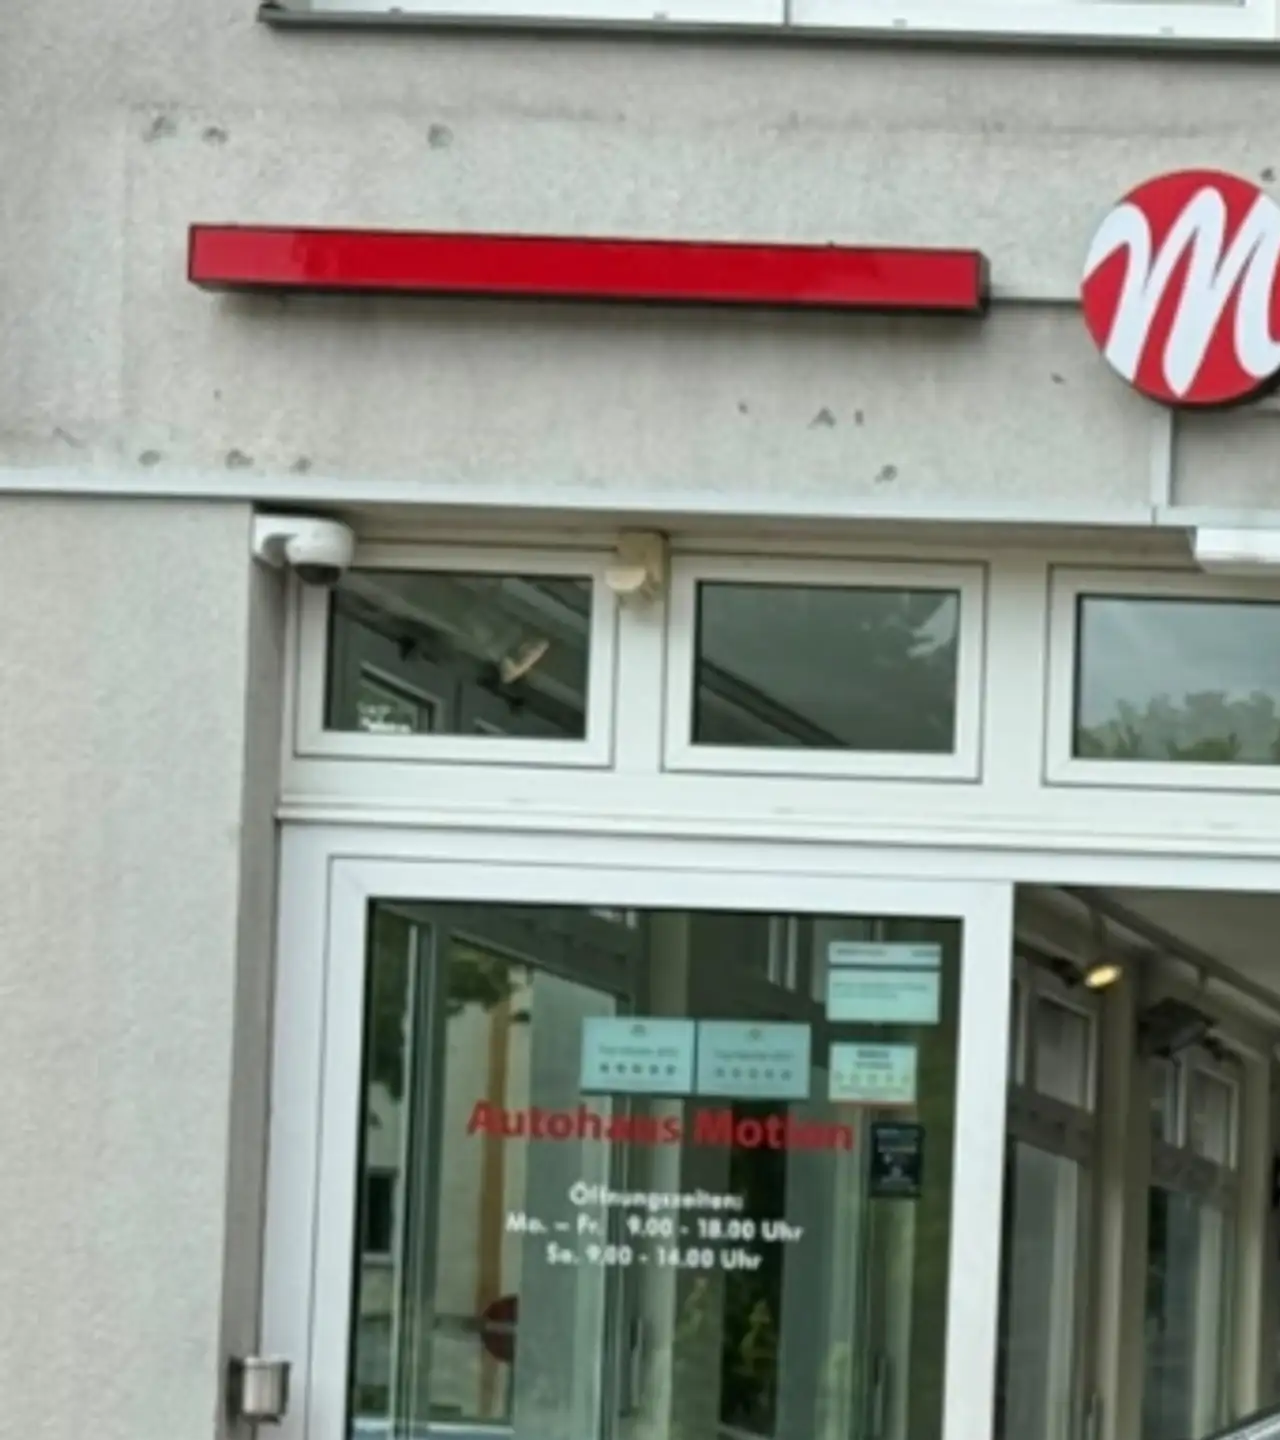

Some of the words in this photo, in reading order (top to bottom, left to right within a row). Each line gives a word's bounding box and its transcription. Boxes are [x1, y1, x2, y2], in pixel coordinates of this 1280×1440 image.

[467, 1102, 681, 1145] Autohaus
[693, 1108, 854, 1151] Motion
[626, 1216, 673, 1237] 9.00
[698, 1217, 756, 1240] 18.00
[761, 1219, 804, 1242] Uhr
[721, 1247, 763, 1270] Uhr
